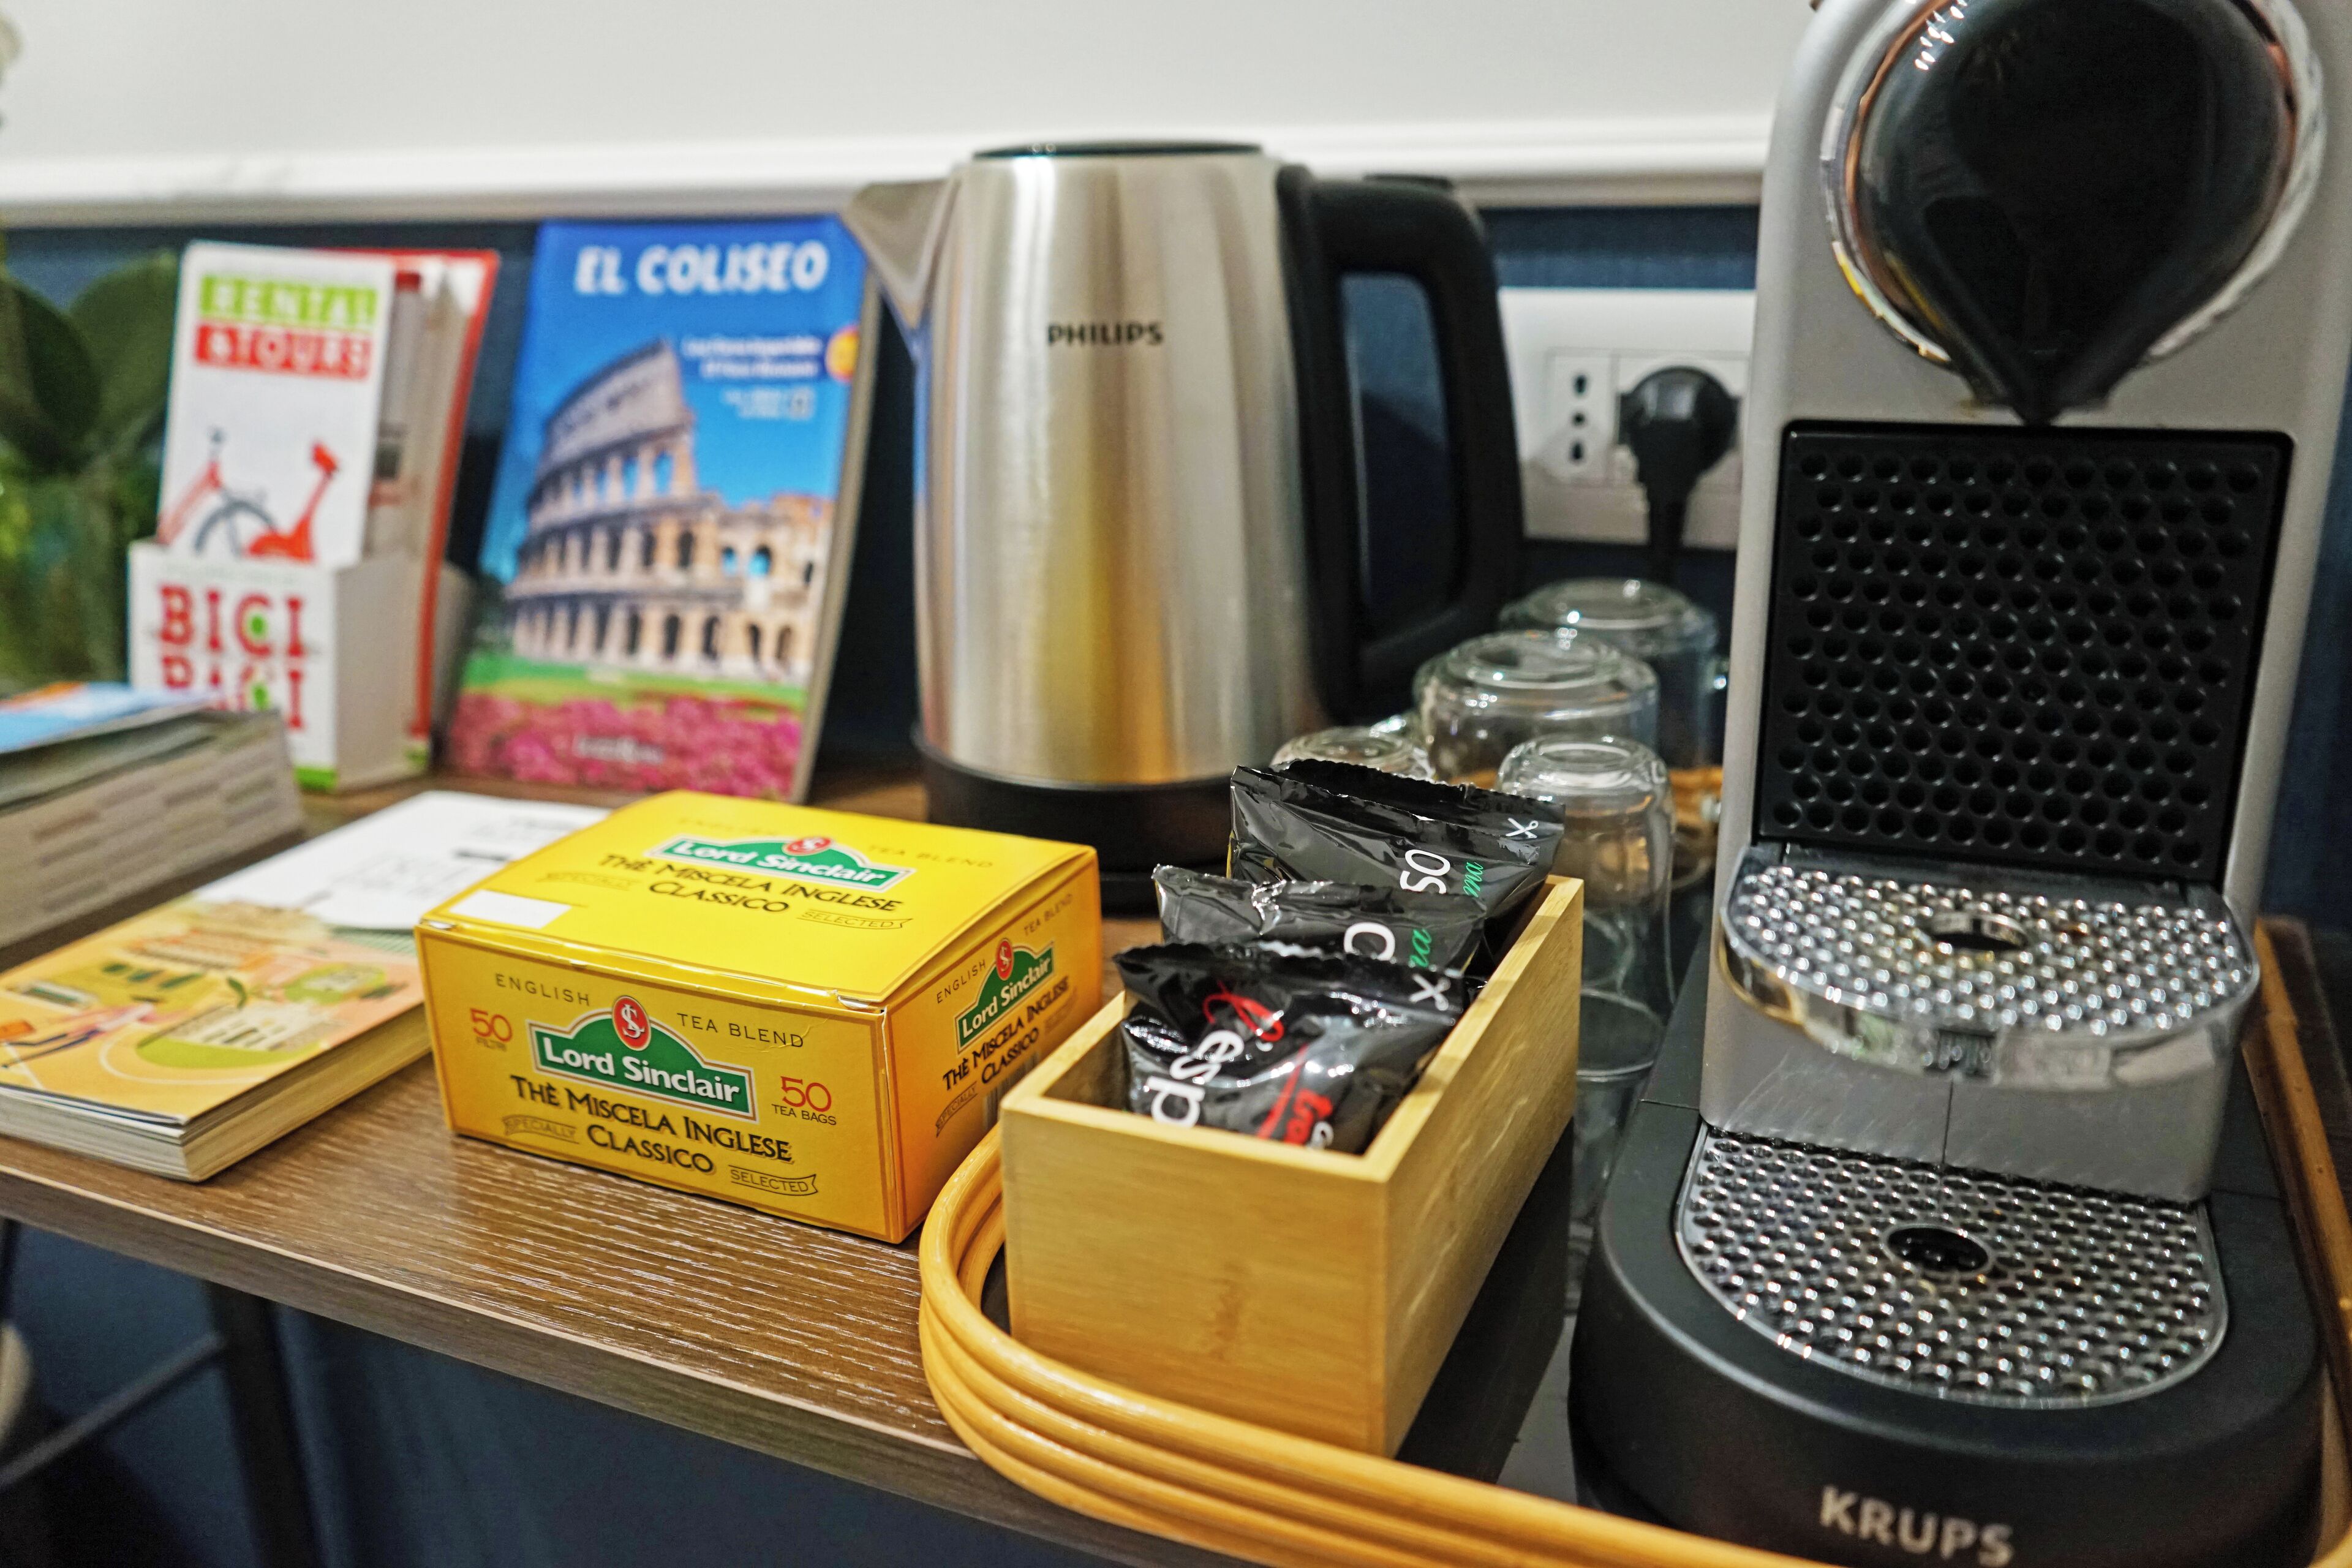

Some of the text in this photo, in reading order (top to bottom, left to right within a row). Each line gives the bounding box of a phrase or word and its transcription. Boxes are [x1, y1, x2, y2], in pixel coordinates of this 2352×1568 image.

[575, 240, 828, 295] EL COLISEO
[1047, 323, 1164, 345] PHILIPS
[158, 585, 304, 658] BICI
[673, 840, 760, 864] Lord
[756, 854, 888, 883] Sinclair
[917, 852, 994, 868] BLEND
[649, 880, 790, 912] CLASSICO
[655, 863, 773, 892] MISCELA
[782, 884, 905, 912] INGLESE
[802, 911, 895, 929] SELECTED
[1023, 893, 1072, 937] TEA BLEND
[495, 973, 590, 1006] ENGLISH
[936, 959, 986, 1005] ENGLISH
[962, 996, 998, 1039] Lord
[1000, 957, 1050, 1008] Sinclair
[470, 1008, 513, 1042] 50
[676, 1012, 804, 1047] TEA BLEND
[972, 1016, 1025, 1070] MISCELA
[1027, 975, 1069, 1023] INGLESE
[543, 1037, 740, 1102] Lord Sinclair
[981, 1027, 1039, 1084] CLASSICO
[772, 1104, 837, 1126] TEA BAGS
[780, 1076, 832, 1112] 50
[937, 1086, 977, 1131] SPECIALLY
[505, 1117, 576, 1137] SPECIALLY
[564, 1087, 677, 1136] MISCELA
[683, 1116, 793, 1162] INGLESE
[587, 1124, 714, 1173] CLASSICO
[730, 1169, 809, 1193] SELECTED
[1819, 1485, 2014, 1567] KRUPS
